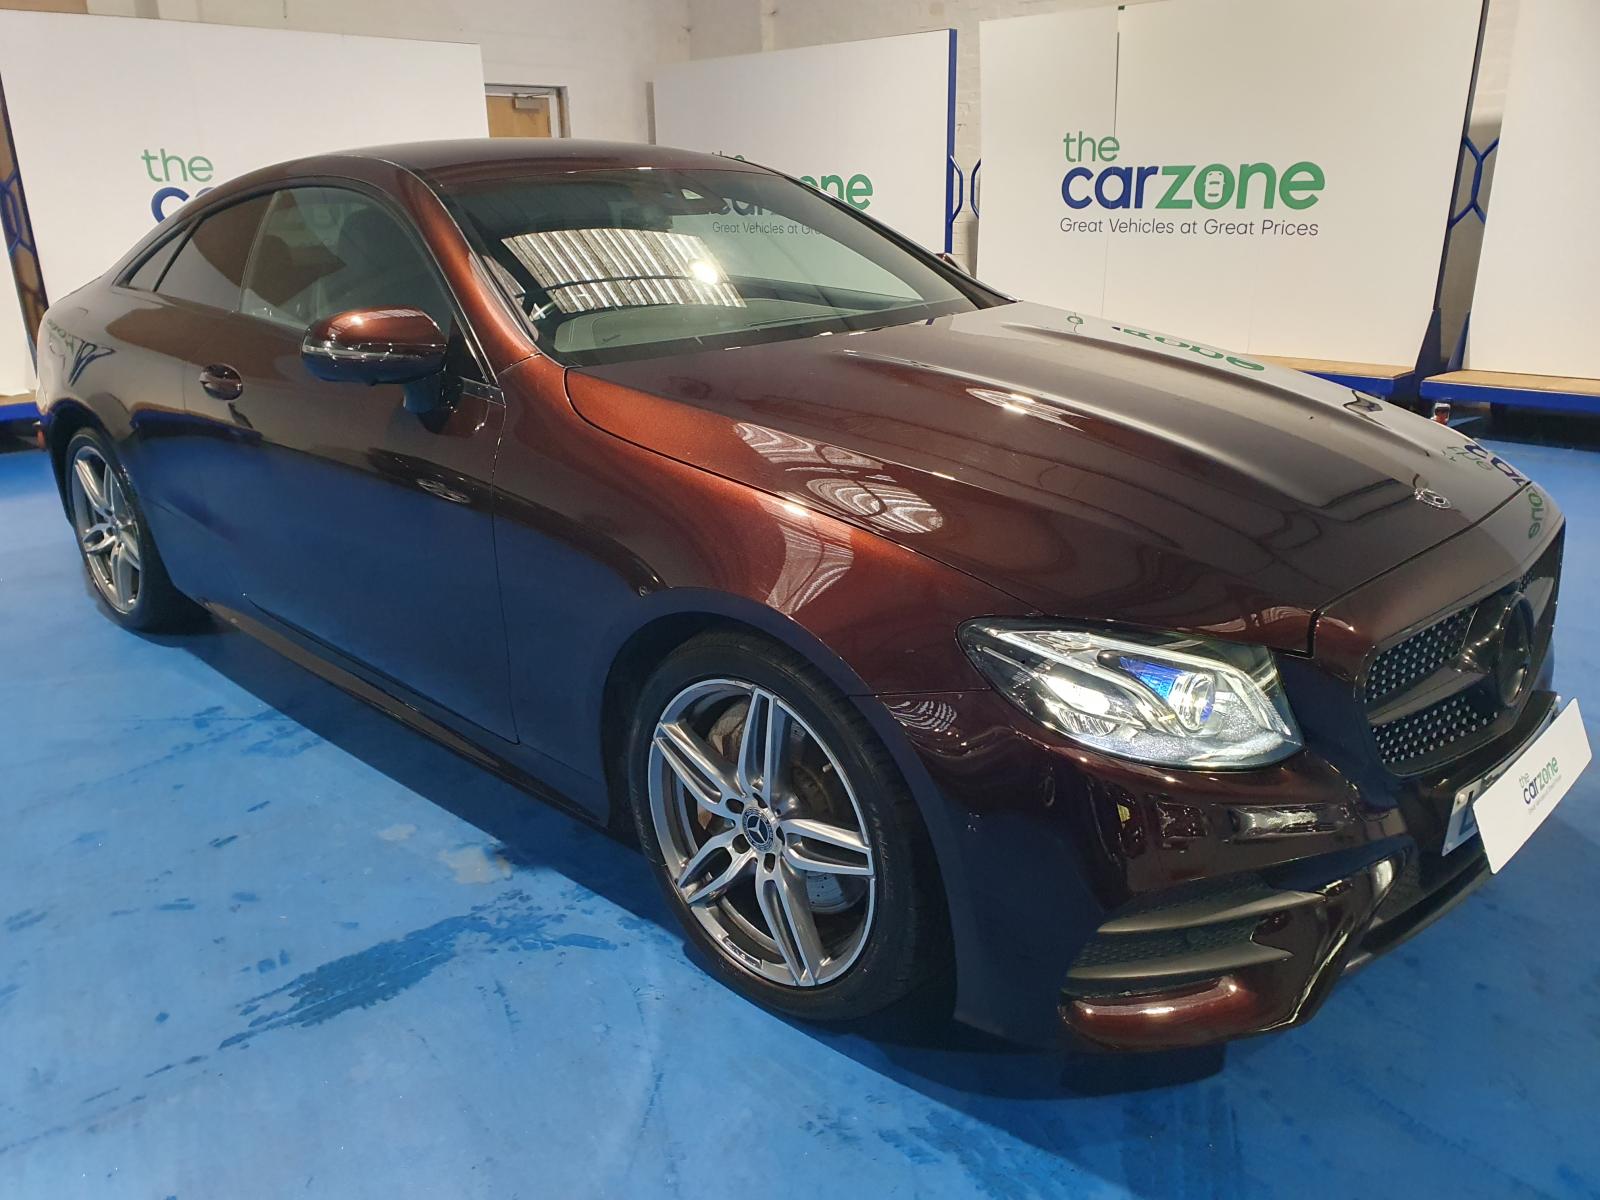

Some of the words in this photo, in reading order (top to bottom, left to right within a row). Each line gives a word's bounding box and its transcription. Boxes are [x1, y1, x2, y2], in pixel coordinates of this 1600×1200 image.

[1062, 131, 1120, 162] the
[141, 148, 213, 182] the
[1061, 161, 1326, 210] carzone
[712, 221, 740, 233] Great
[742, 222, 784, 234] Vehicles
[787, 223, 799, 234] at
[1060, 217, 1103, 232] Great
[1109, 218, 1174, 233] Vehicles
[1180, 220, 1198, 234] at
[1204, 219, 1255, 234] Great
[1261, 219, 1319, 235] Prices
[1523, 756, 1559, 804] carzone
